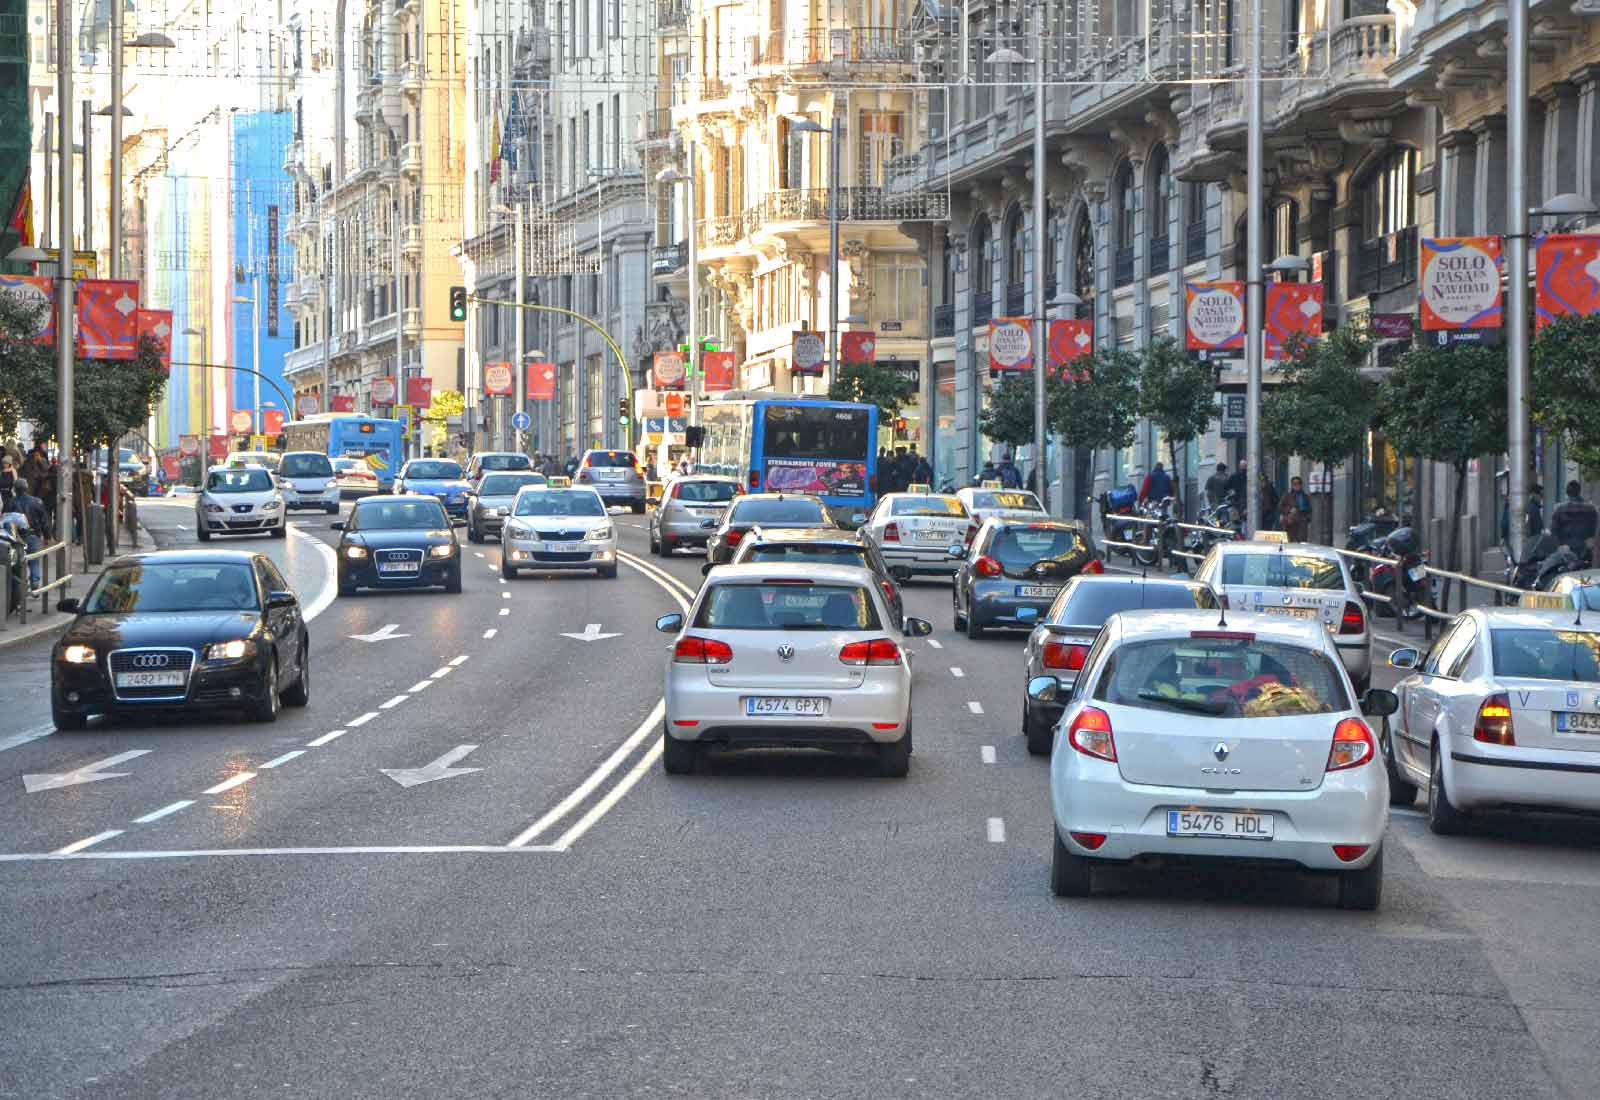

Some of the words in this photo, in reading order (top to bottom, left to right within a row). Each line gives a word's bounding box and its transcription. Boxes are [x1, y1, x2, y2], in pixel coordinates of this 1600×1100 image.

[1438, 255, 1486, 271] SOLO
[1436, 271, 1473, 283] PASA
[1432, 283, 1489, 299] NAVIDAD
[1199, 295, 1233, 306] SOLO
[757, 699, 790, 711] 4574
[795, 699, 820, 712] GPX
[1518, 691, 1530, 707] V
[1570, 714, 1600, 728] 843
[1181, 814, 1224, 832] 5476
[1235, 816, 1268, 834] HDL
